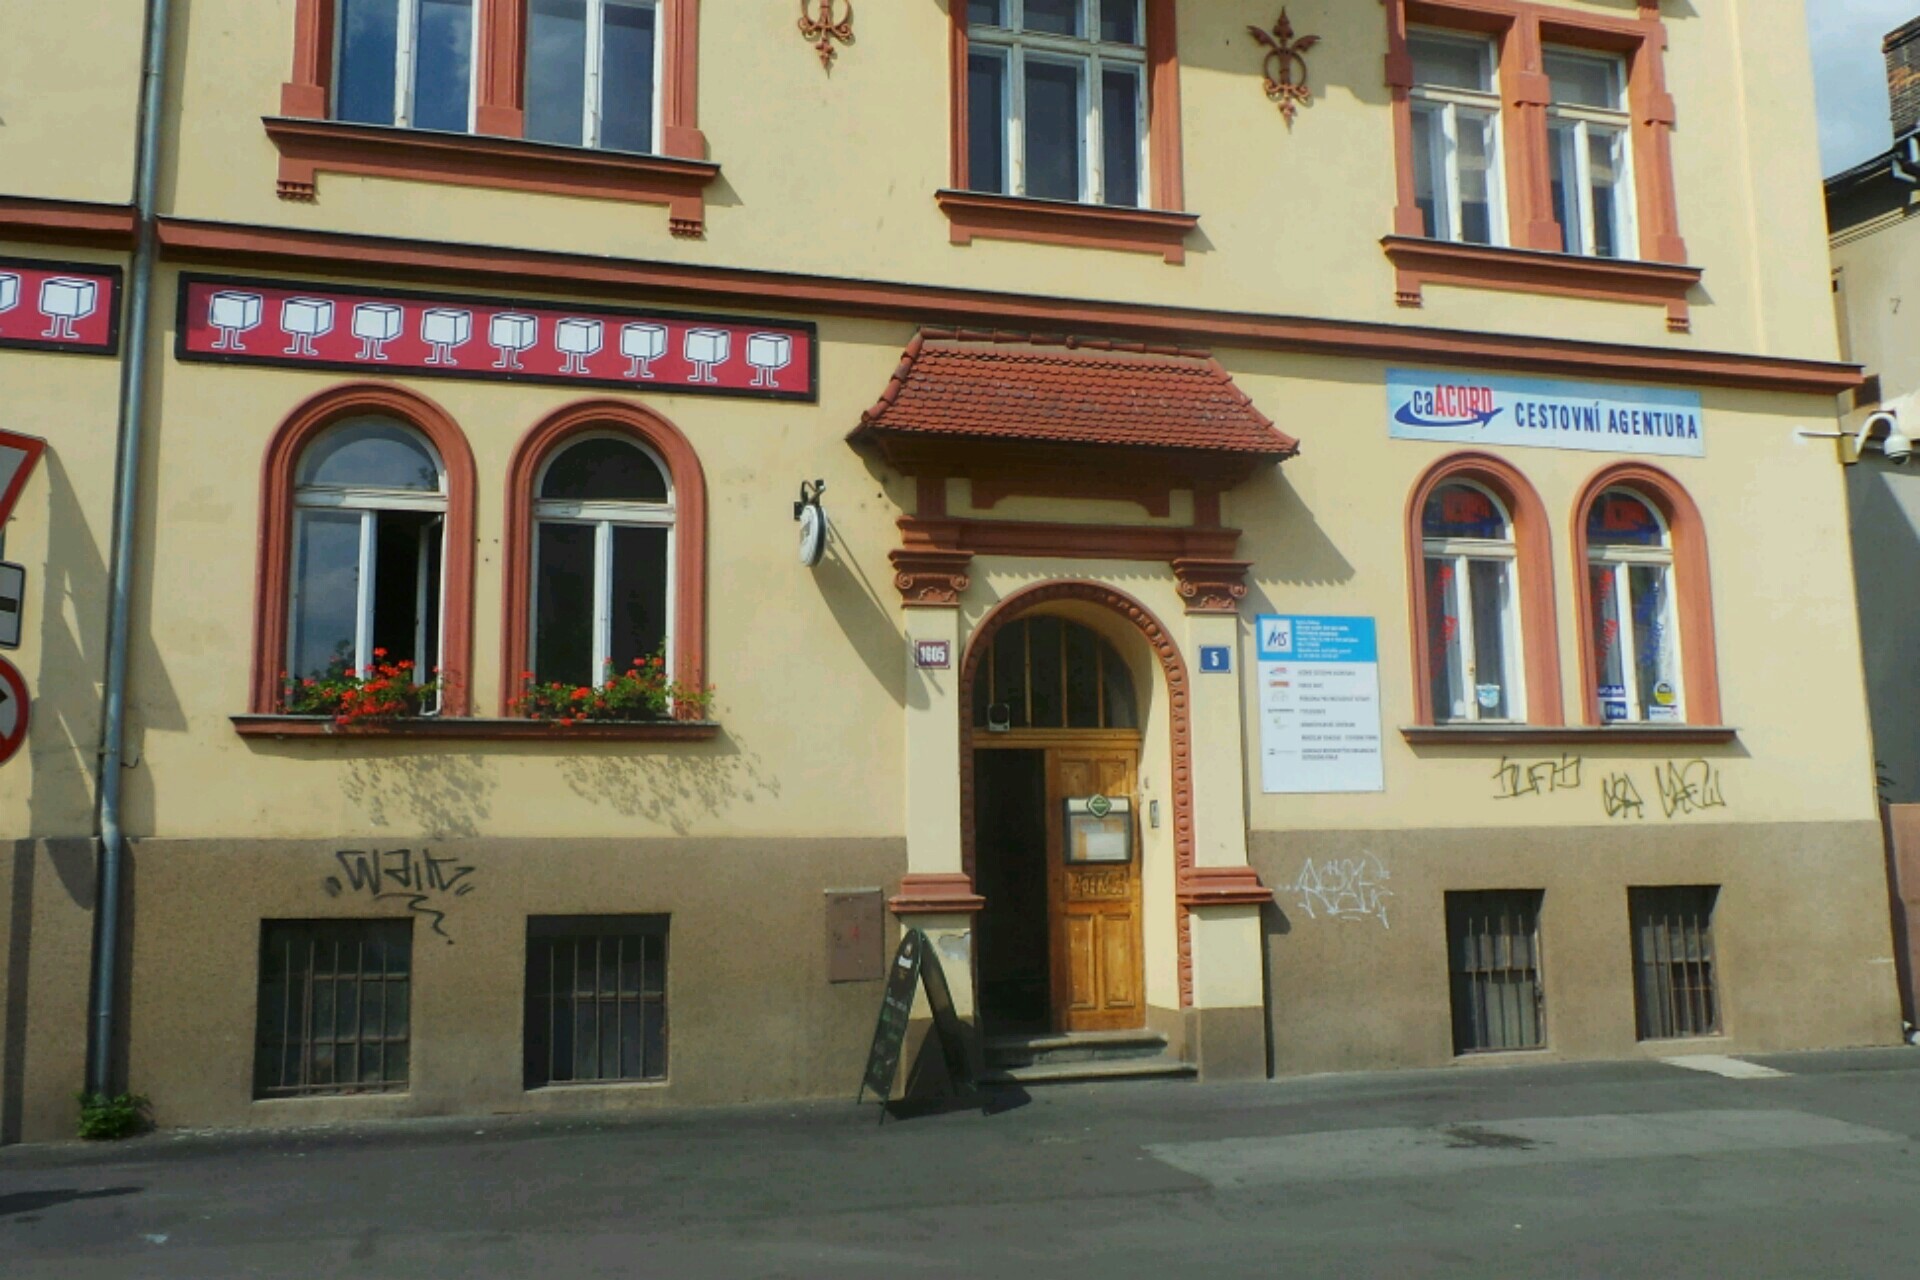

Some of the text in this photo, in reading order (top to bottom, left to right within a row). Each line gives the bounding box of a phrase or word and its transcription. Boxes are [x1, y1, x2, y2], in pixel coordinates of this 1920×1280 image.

[1515, 401, 1600, 433] CESTOVNÍ
[1608, 408, 1698, 439] AGENTURA
[1211, 651, 1219, 666] 5
